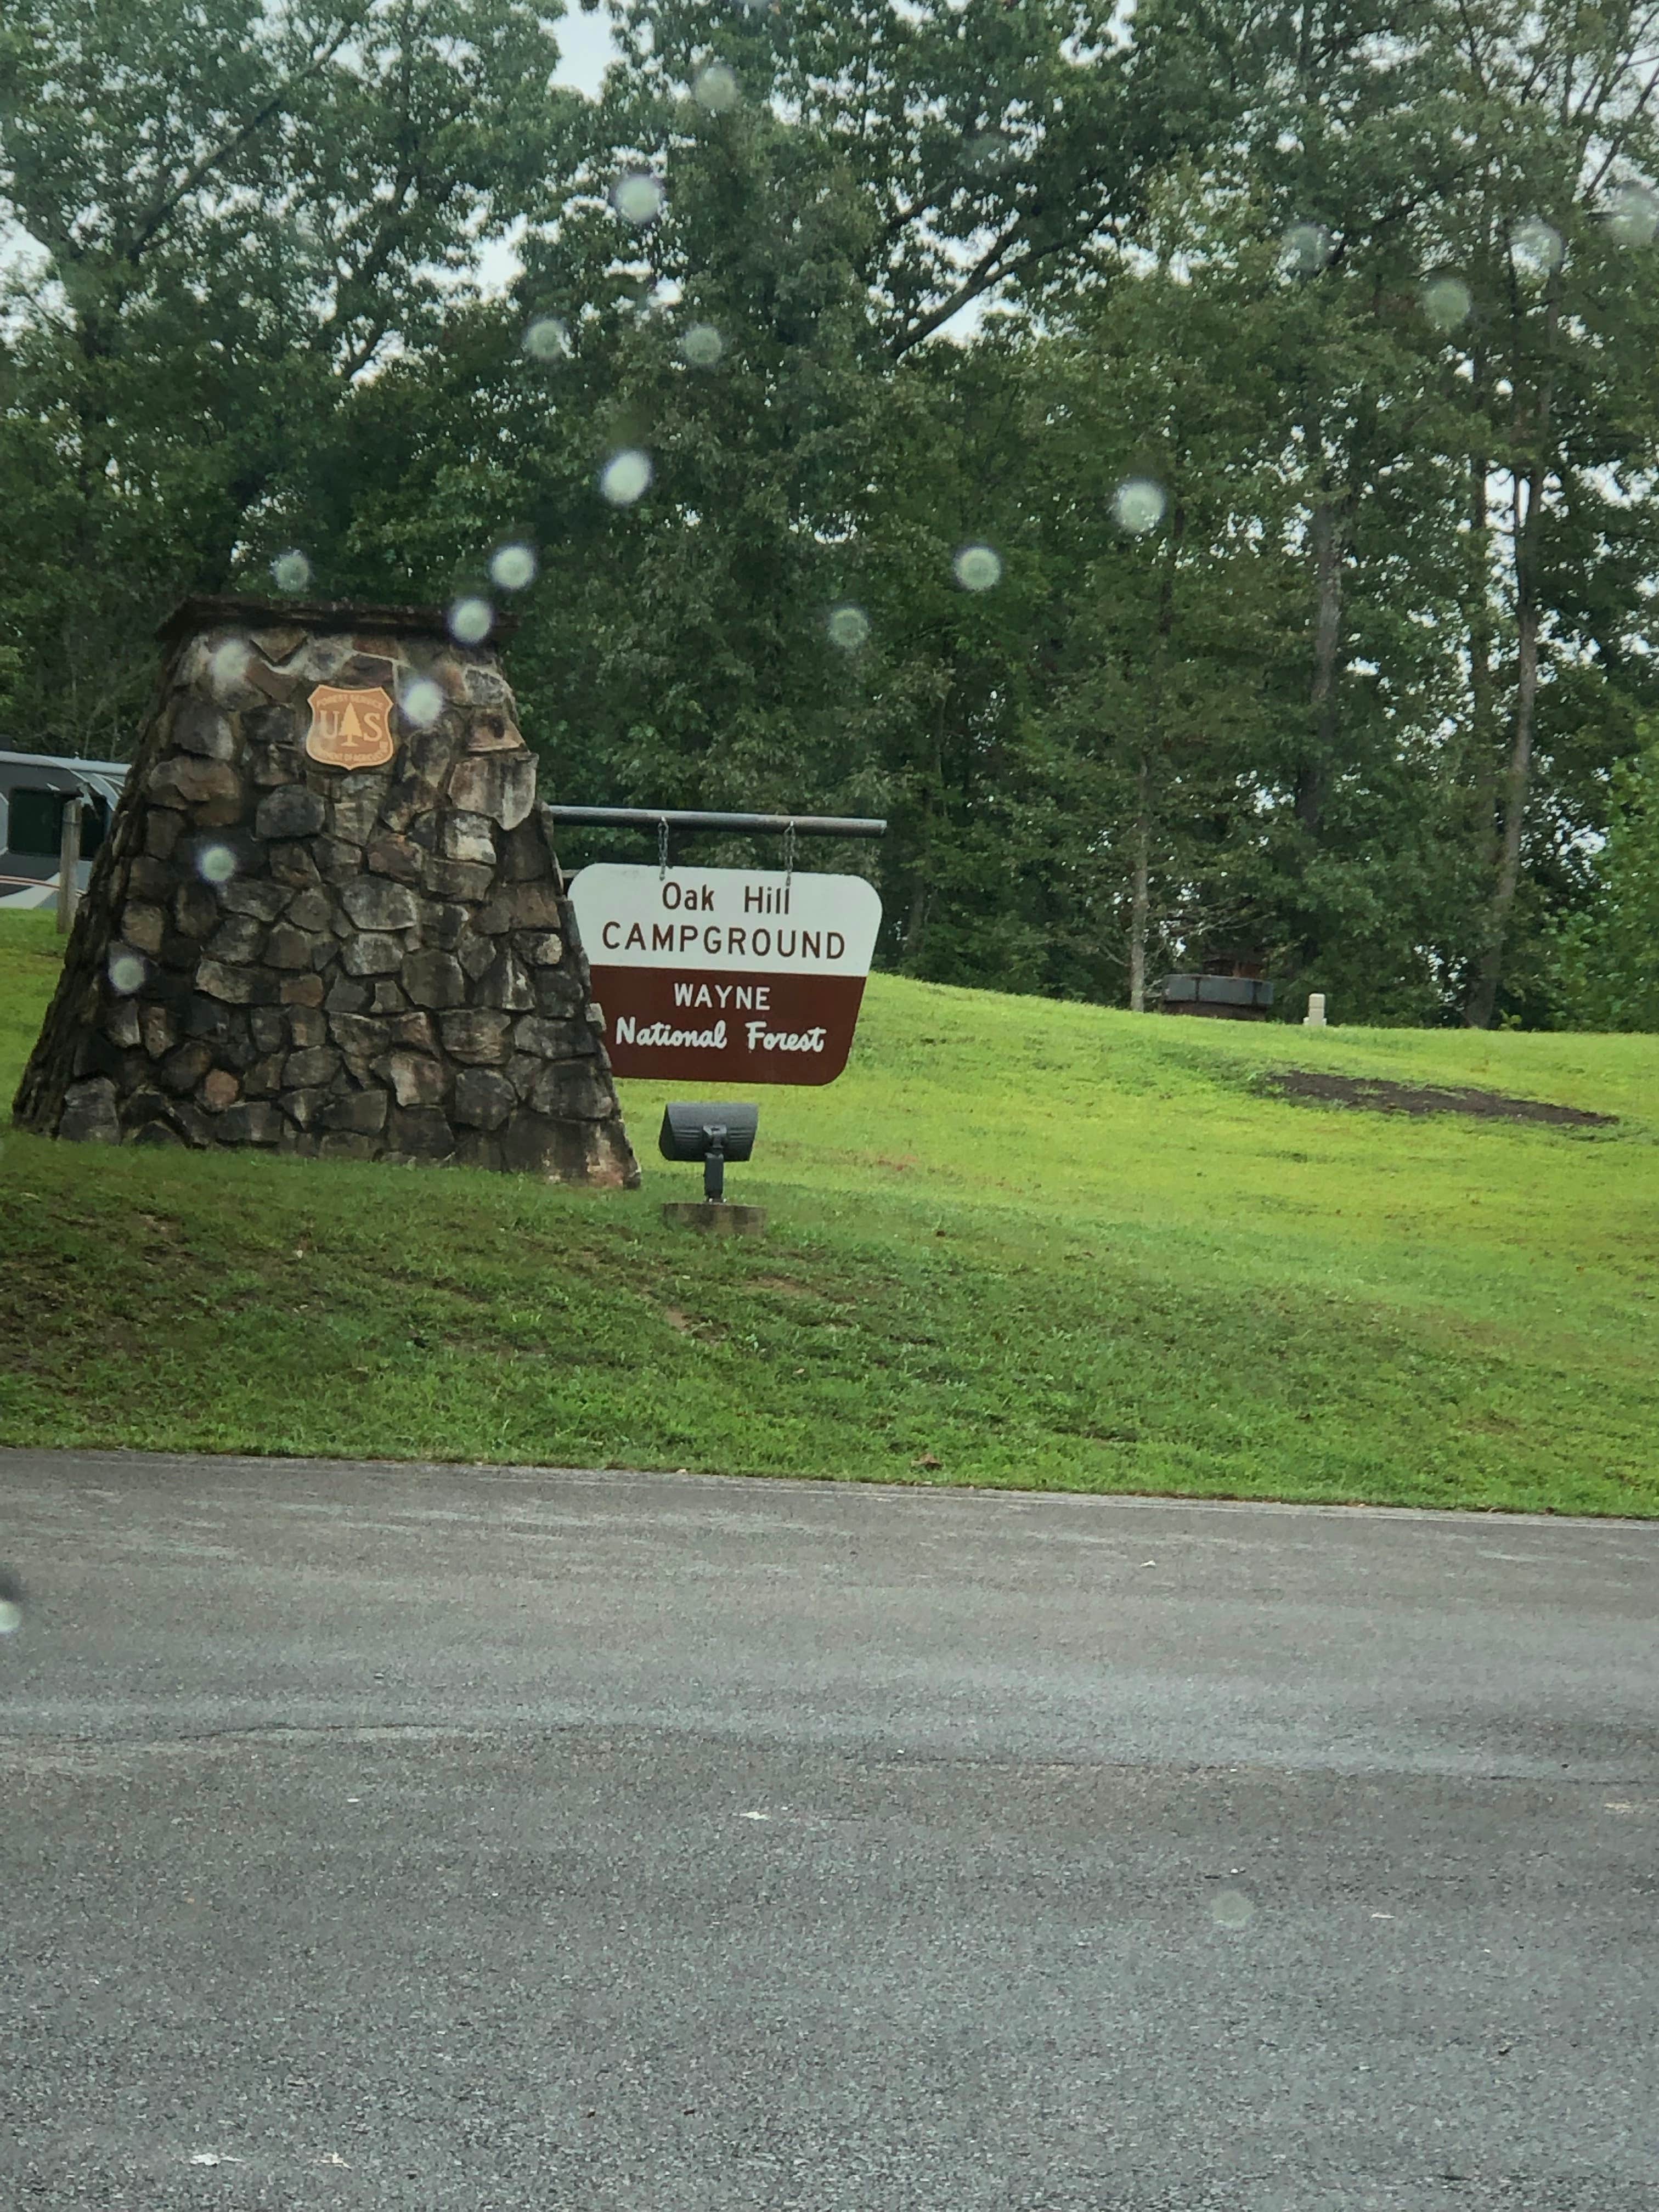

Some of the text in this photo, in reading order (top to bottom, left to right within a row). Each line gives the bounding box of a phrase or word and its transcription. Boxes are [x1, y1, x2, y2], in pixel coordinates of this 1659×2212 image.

[320, 710, 383, 742] U S
[662, 881, 790, 915] Oak Hill
[602, 921, 845, 960] CAMPGROUND
[674, 982, 771, 1011] WAYNE
[616, 1016, 827, 1053] National Forest
